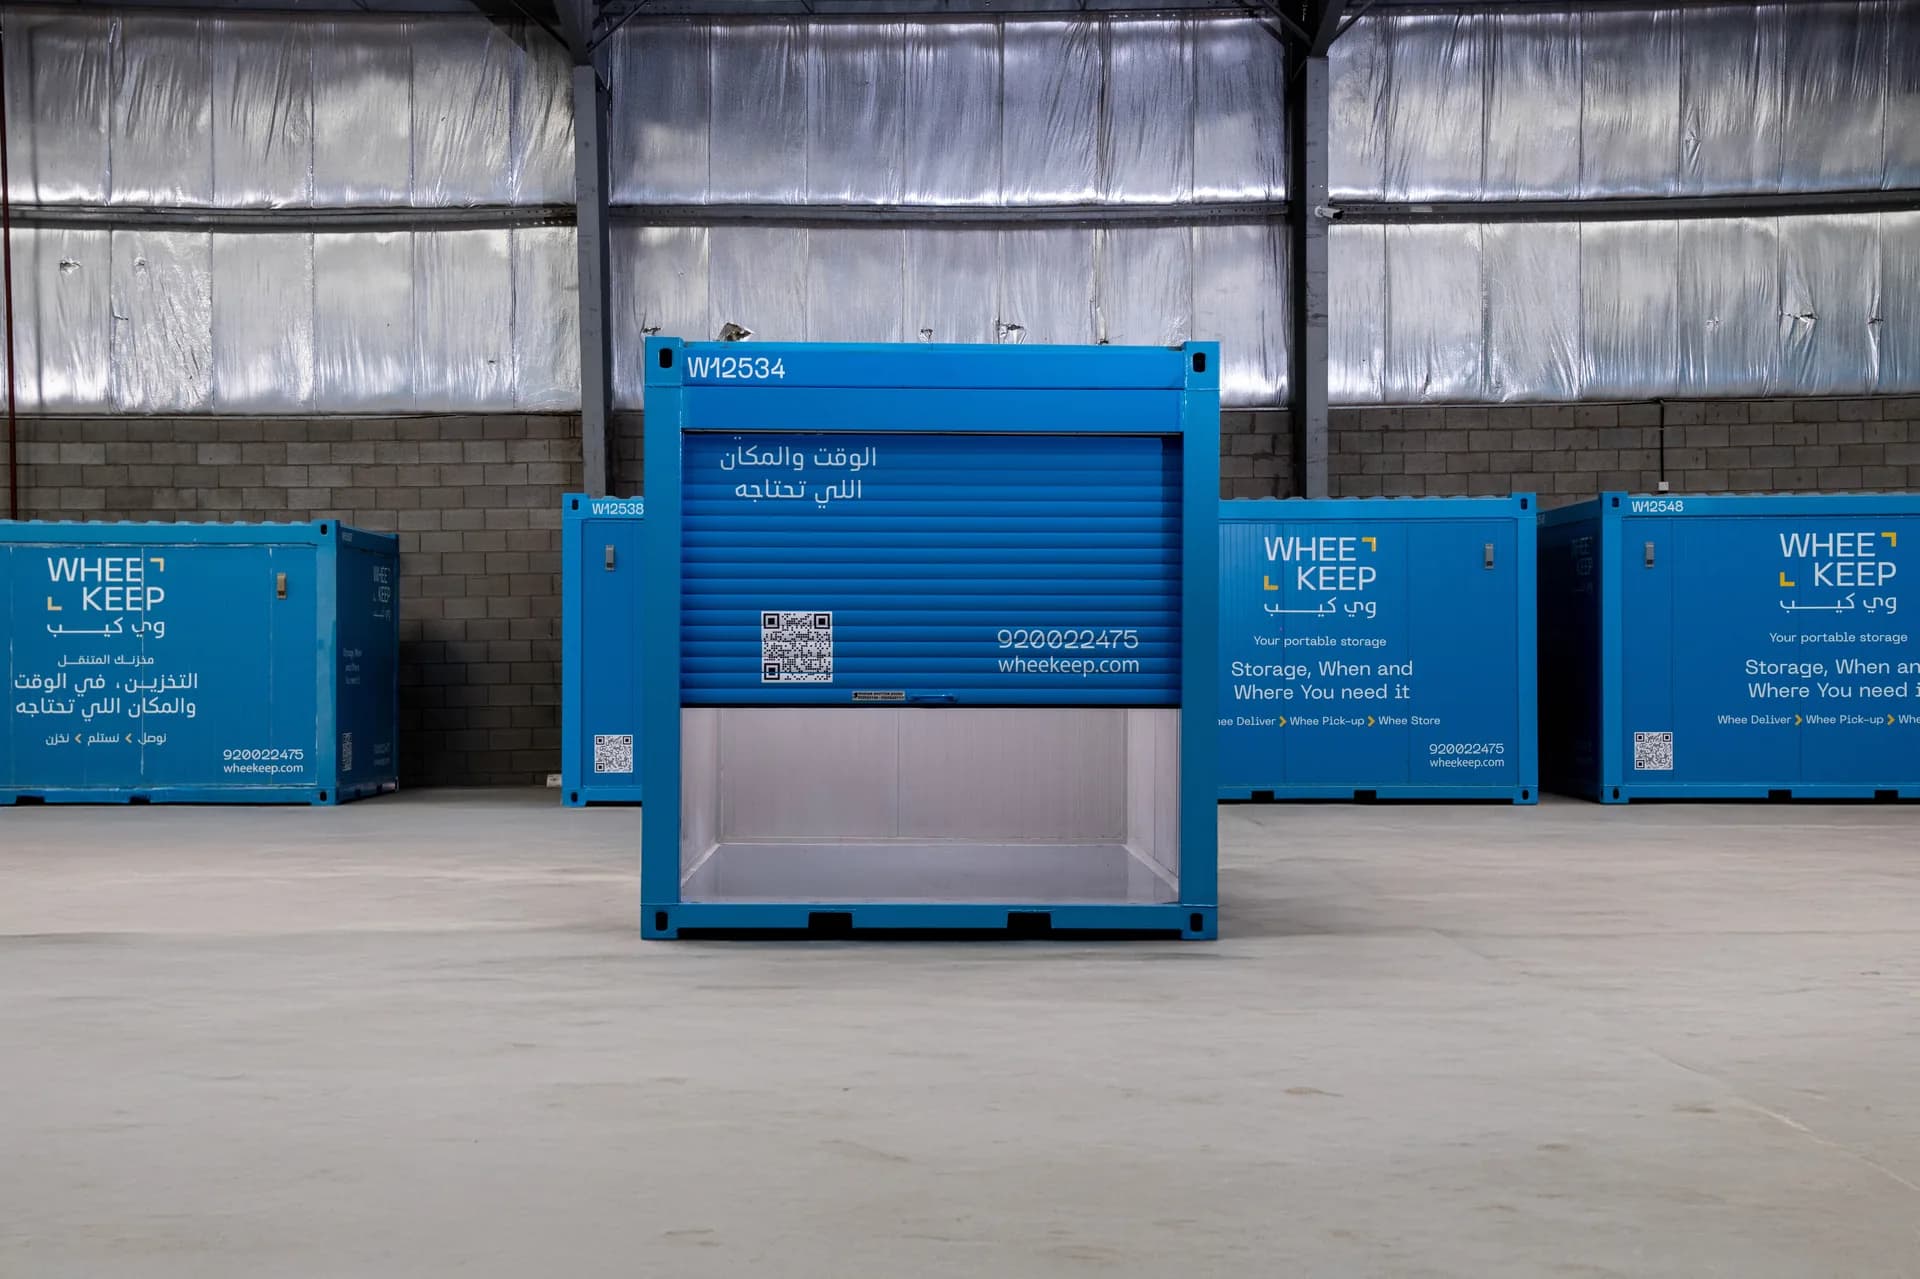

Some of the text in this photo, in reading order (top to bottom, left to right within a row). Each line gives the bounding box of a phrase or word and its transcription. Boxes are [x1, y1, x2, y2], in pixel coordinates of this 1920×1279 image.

[687, 356, 786, 379] W12534
[720, 444, 877, 472] الوقت والمكان
[735, 478, 862, 509] اللي تحتاجه
[591, 501, 645, 516] W12538
[1631, 500, 1684, 513] W12548
[1263, 536, 1357, 562] WHEE
[1779, 532, 1876, 558] WHEE
[47, 556, 143, 583] WHEE
[1297, 565, 1377, 591] KEEP
[1814, 561, 1897, 587] KEEP
[82, 585, 165, 612] KEEP
[1862, 596, 1897, 615] وي
[1343, 601, 1377, 619] وي
[131, 618, 165, 640] وي
[997, 629, 1140, 650] 920022475
[1769, 631, 1909, 645] Your portable storage
[1253, 635, 1387, 649] Your portable storage
[57, 654, 155, 668] مخزنك المتنقل
[997, 655, 1140, 678] wheekeep.com
[1231, 659, 1413, 681] Storage, When and
[1745, 658, 1828, 679] Storage,
[1835, 658, 1890, 675] When
[14, 672, 67, 694] الوقت
[74, 673, 106, 698] في
[1233, 683, 1411, 700] Where You need it
[1748, 681, 1810, 699] Where
[1816, 682, 1852, 698] You
[1859, 681, 1908, 698] need
[15, 696, 197, 723] والمكان اللي تحتاجه
[1717, 714, 1748, 725] Whee
[1750, 714, 1792, 725] Deliver
[1805, 714, 1837, 725] Whee
[1839, 714, 1885, 726] Pick-up
[1236, 715, 1277, 726] Deliver
[1289, 715, 1320, 726] Whee
[1322, 715, 1365, 728] Pick-up
[1378, 715, 1408, 726] Whee
[1410, 715, 1441, 726] Store
[45, 732, 168, 747] نوصل نستلم نخزن
[1429, 742, 1505, 755] 920022475
[222, 748, 304, 761] 920022475
[1429, 756, 1505, 769] wheekeep.com
[223, 762, 304, 776] wheekeep.com
